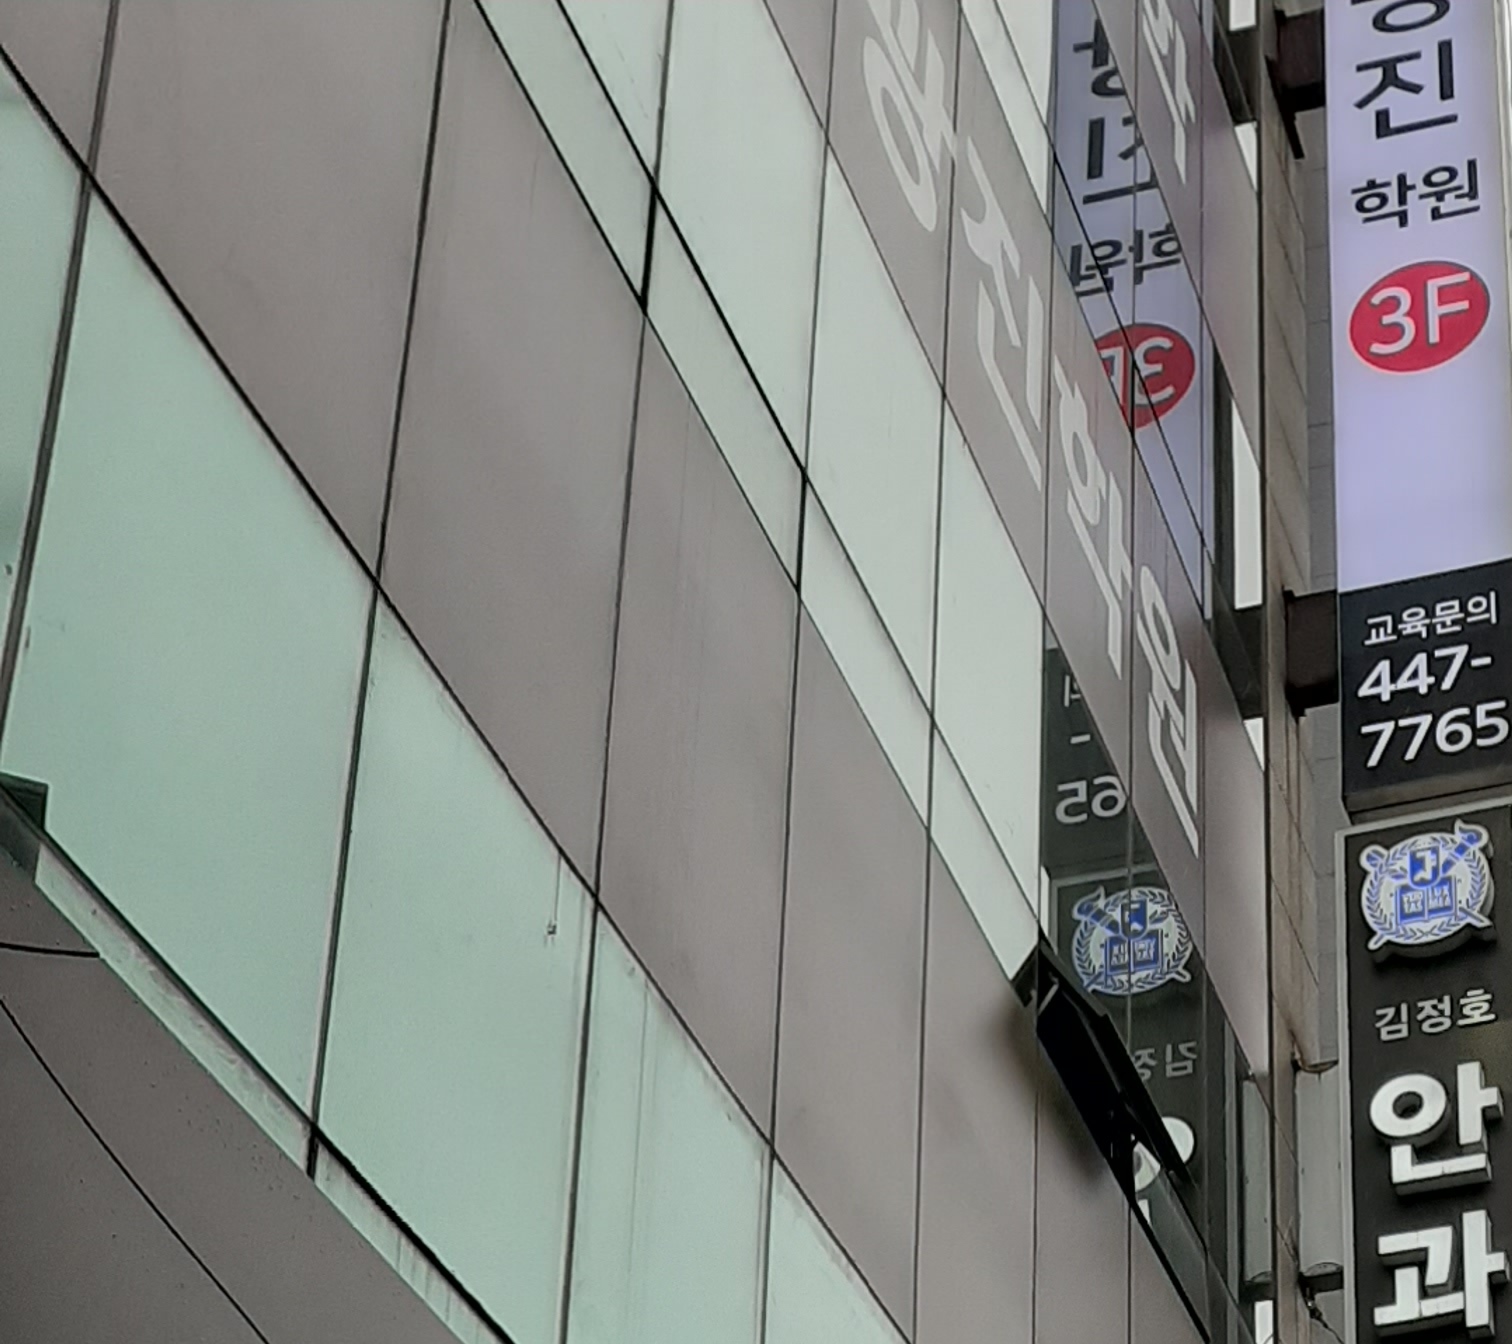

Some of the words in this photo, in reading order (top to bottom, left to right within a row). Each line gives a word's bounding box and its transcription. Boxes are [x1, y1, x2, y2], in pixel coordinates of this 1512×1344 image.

[1351, 158, 1480, 228] 학원
[1368, 271, 1471, 356] 3F
[1363, 591, 1499, 647] 교육문의
[1357, 645, 1493, 703] 447-
[1360, 700, 1511, 768] 7765
[1373, 987, 1497, 1042] 김정호
[1368, 1060, 1510, 1340] 안과
